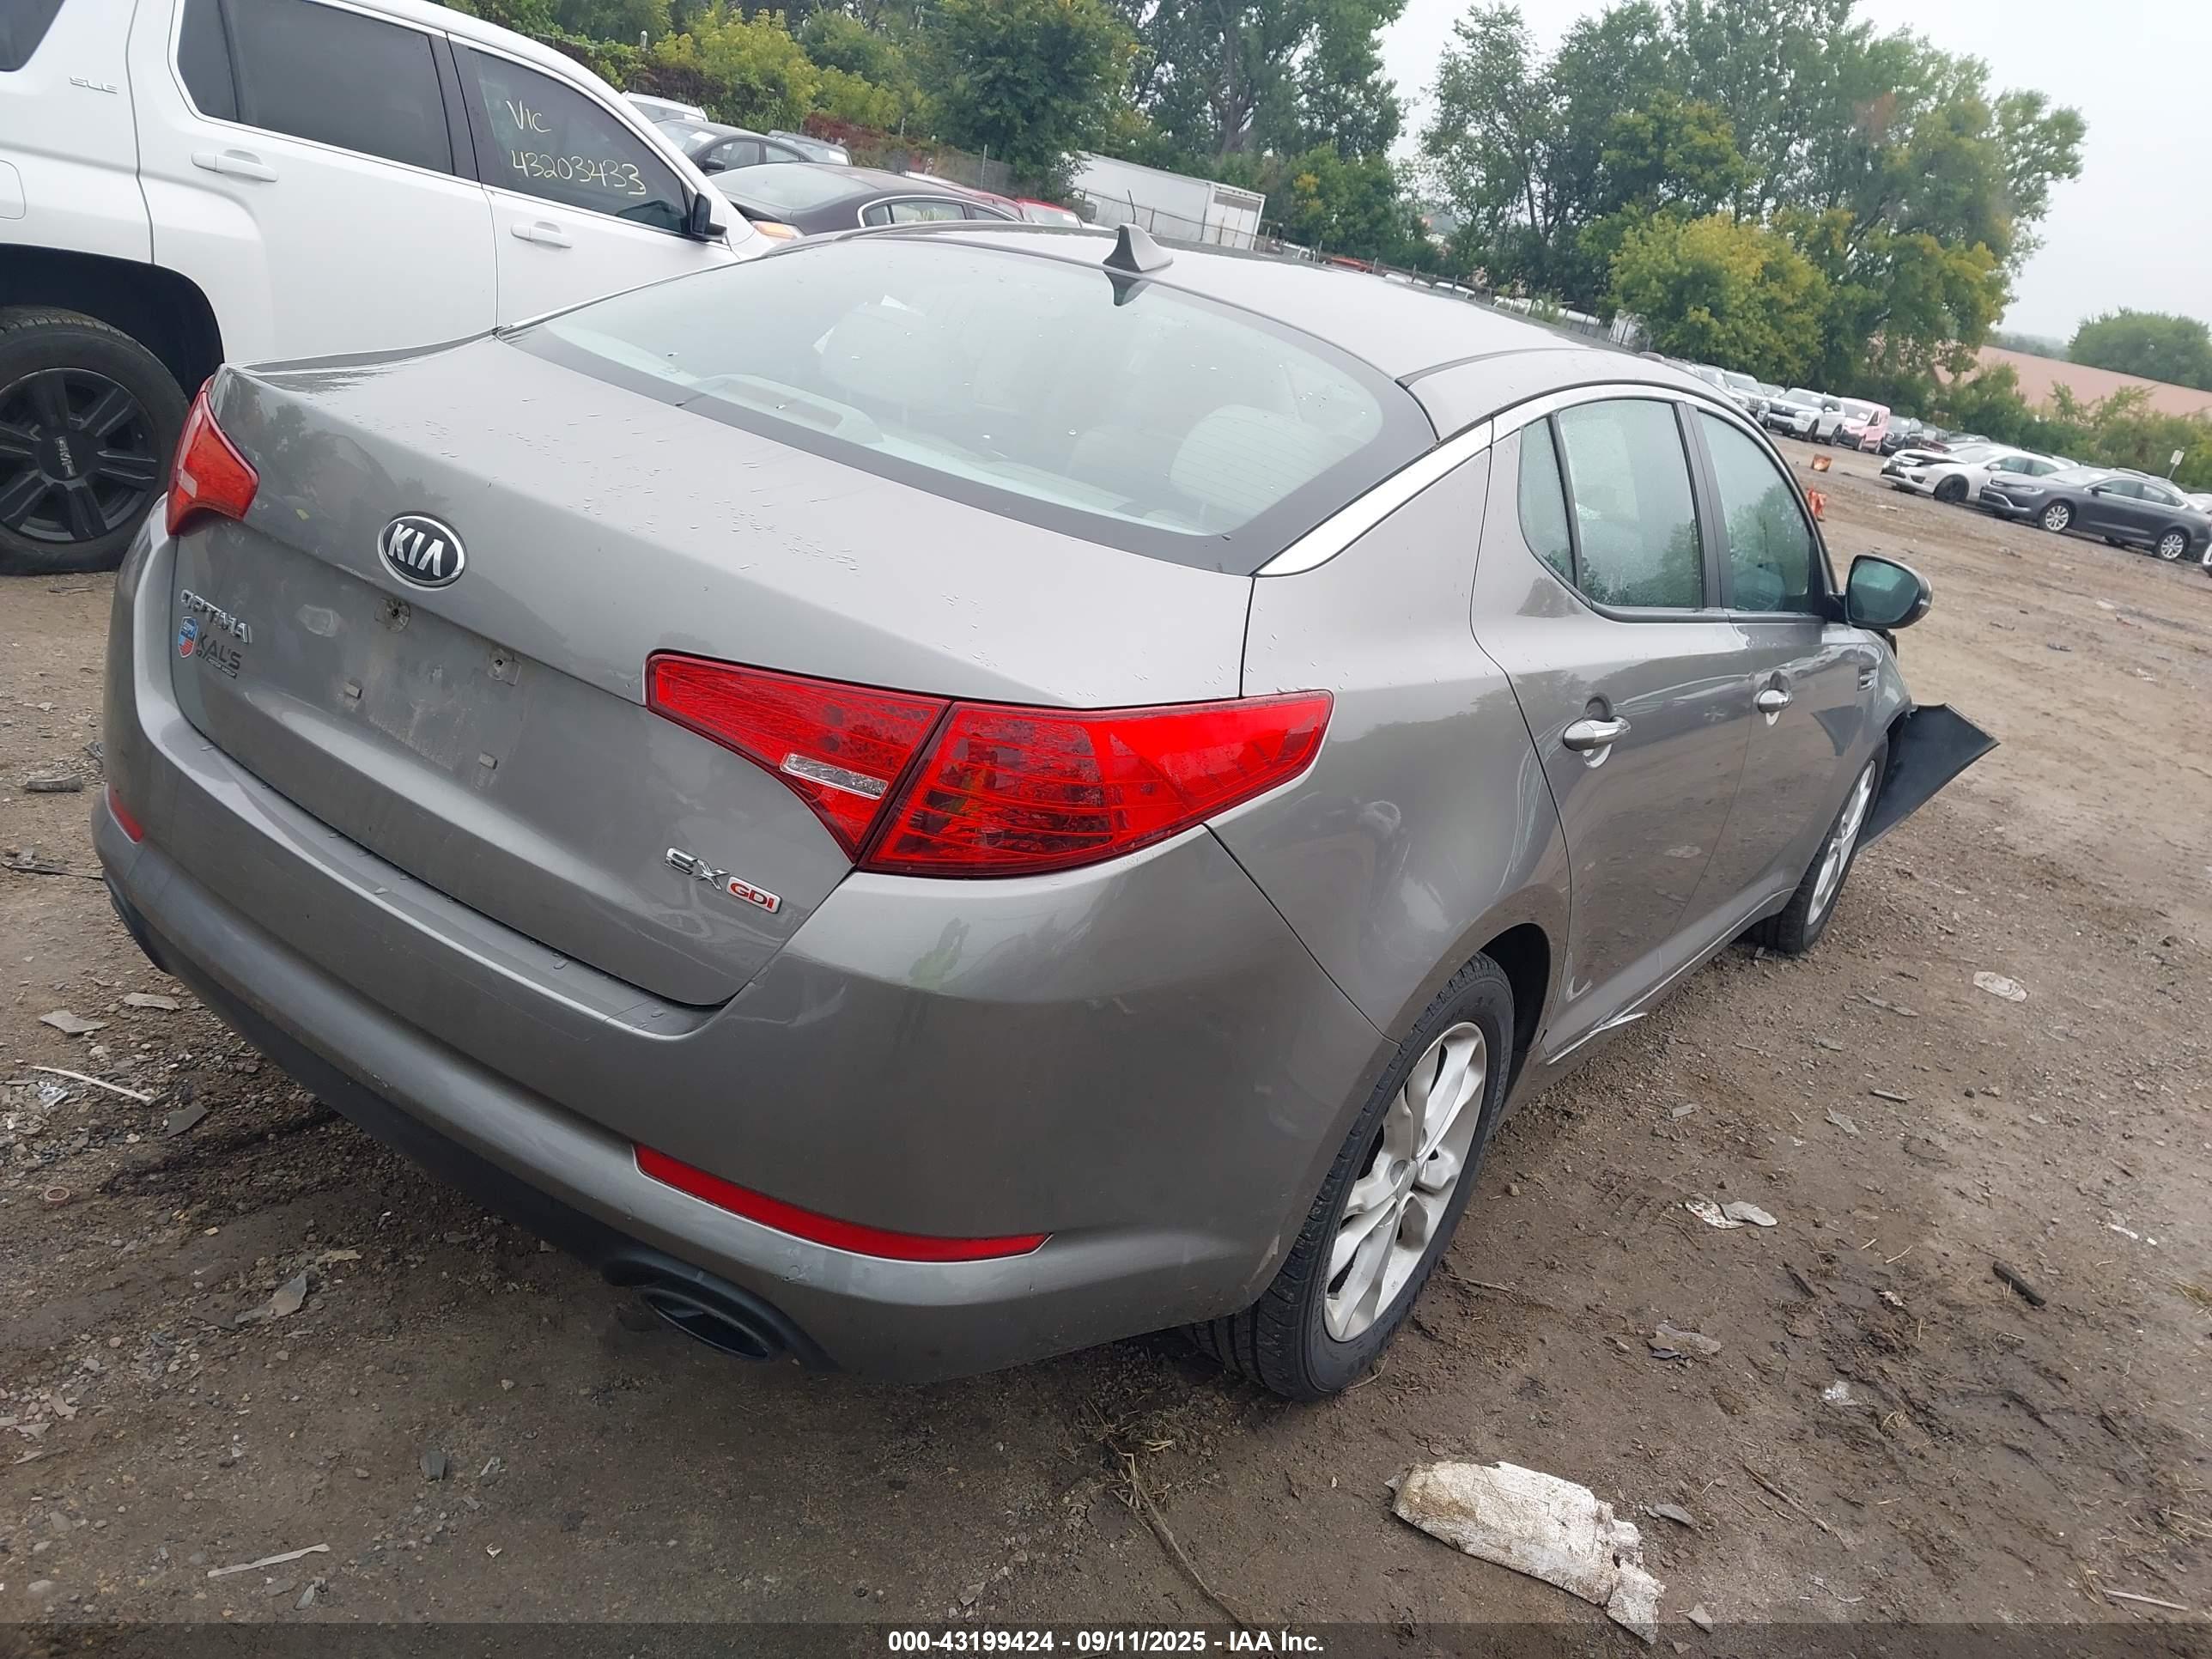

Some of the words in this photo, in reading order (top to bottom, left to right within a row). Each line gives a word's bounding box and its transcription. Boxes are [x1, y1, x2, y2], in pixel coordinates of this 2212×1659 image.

[69, 76, 118, 94] SLE
[506, 100, 552, 132] VIC
[511, 149, 647, 196] 43203433
[387, 523, 445, 577] KIA
[730, 883, 775, 908] GDI
